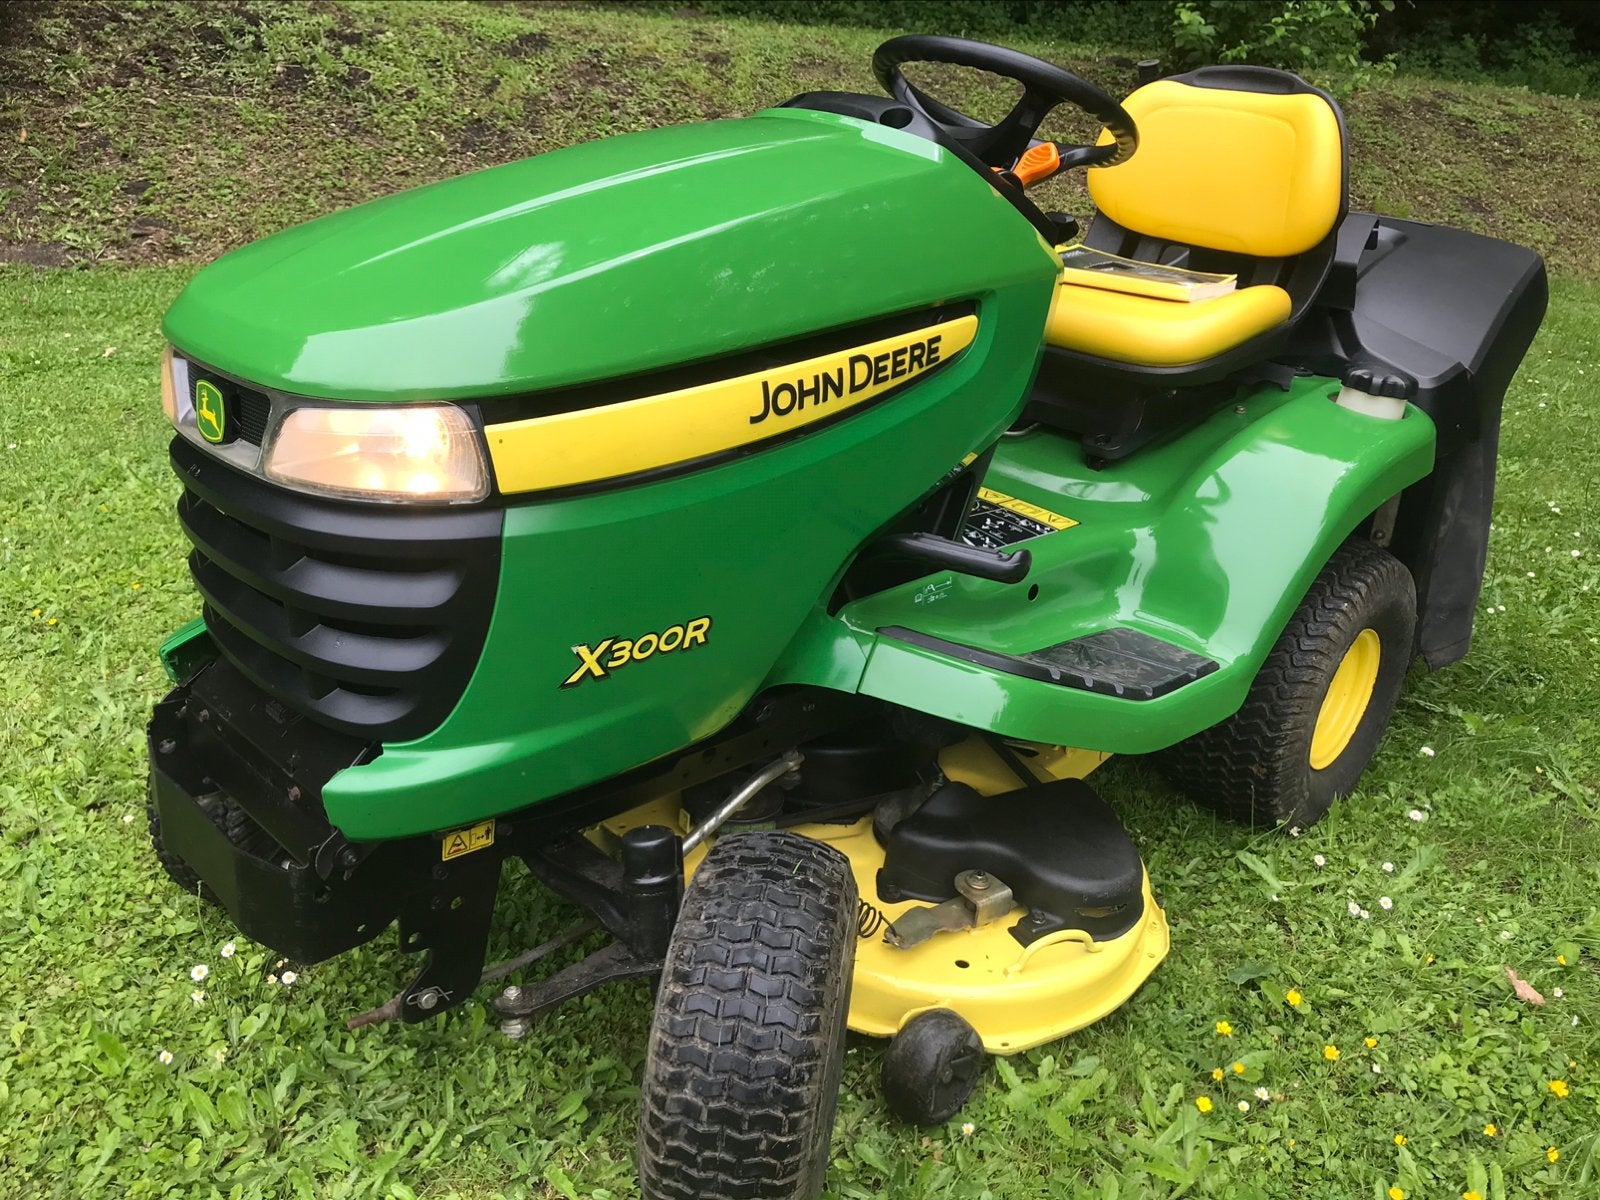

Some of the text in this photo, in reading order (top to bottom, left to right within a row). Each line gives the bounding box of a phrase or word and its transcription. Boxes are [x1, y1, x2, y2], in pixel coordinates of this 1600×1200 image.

[749, 334, 942, 425] JOHN DEERE
[560, 615, 712, 688] X300R
